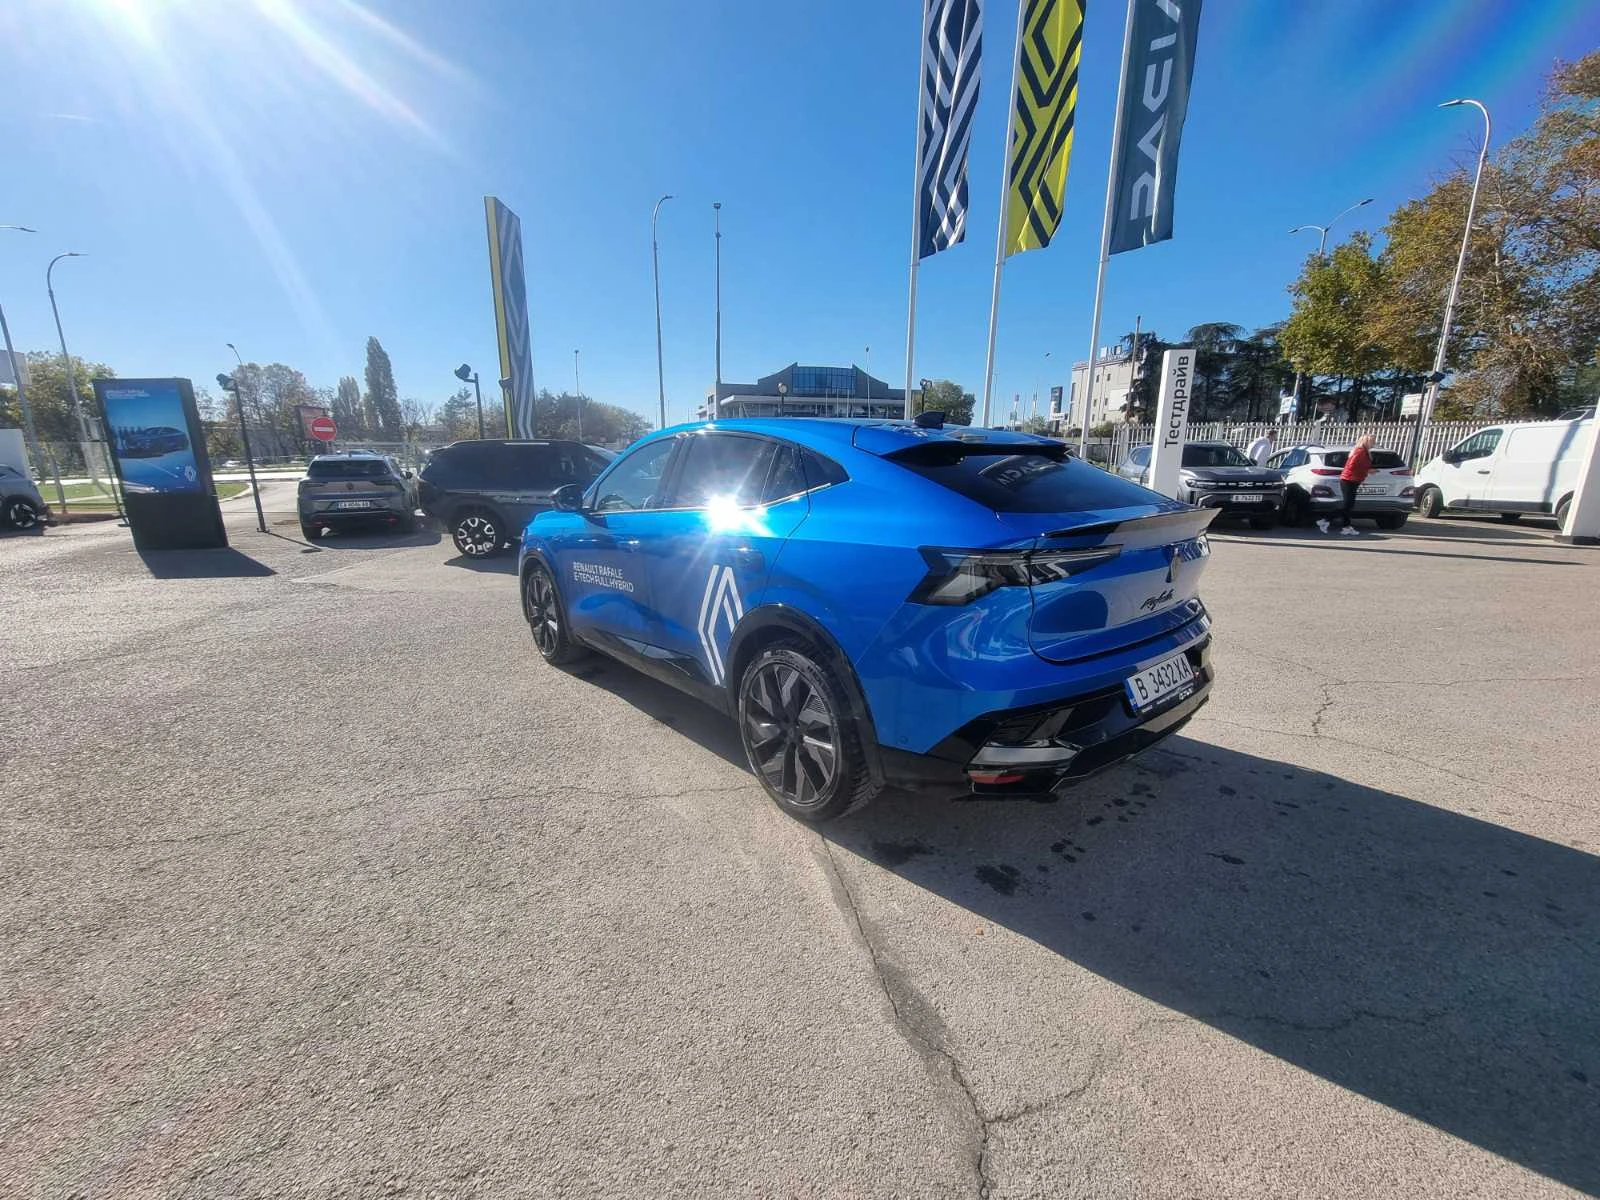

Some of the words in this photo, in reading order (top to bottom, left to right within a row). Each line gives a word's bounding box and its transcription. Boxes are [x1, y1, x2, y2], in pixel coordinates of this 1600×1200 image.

[1164, 355, 1189, 449] Тестдрайв
[573, 561, 598, 575] RENAULT
[599, 564, 624, 580] RAFALE
[574, 571, 595, 585] E-TECH
[595, 575, 611, 588] FULL
[610, 577, 634, 593] HYBRID
[1149, 663, 1179, 694] 3432
